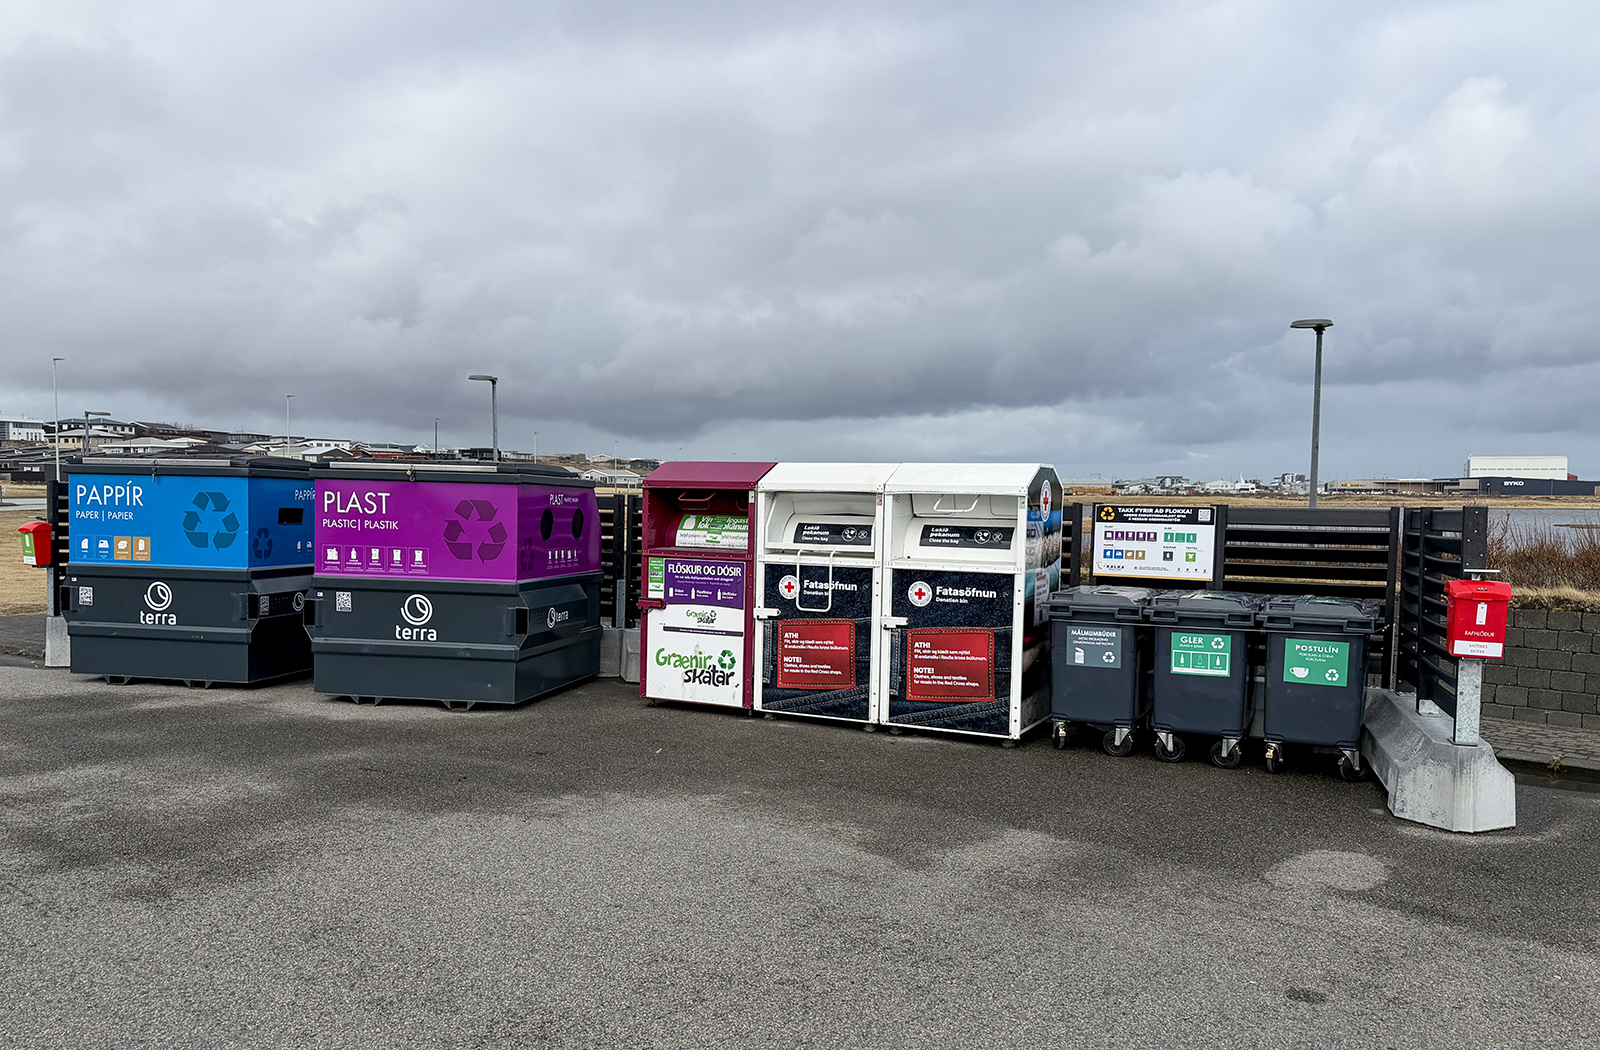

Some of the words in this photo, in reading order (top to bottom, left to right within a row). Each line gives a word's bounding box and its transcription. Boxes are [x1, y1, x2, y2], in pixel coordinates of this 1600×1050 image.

[76, 480, 143, 507] PAPPÍR
[323, 491, 391, 515] PLAST
[75, 510, 99, 520] PAPER
[107, 511, 134, 521] PAPIER
[364, 520, 399, 531] PLASTIK
[668, 562, 702, 575] FLÖSKUR
[703, 565, 716, 575] OG
[717, 565, 742, 577] DÓSIR
[803, 579, 858, 591] Fatasöfnun
[936, 586, 997, 598] Fatasöfnun
[140, 611, 177, 625] terra
[395, 625, 437, 641] terra
[1180, 636, 1204, 644] GLER
[1295, 644, 1339, 654] POSTULÍN
[683, 664, 735, 687] skátar
